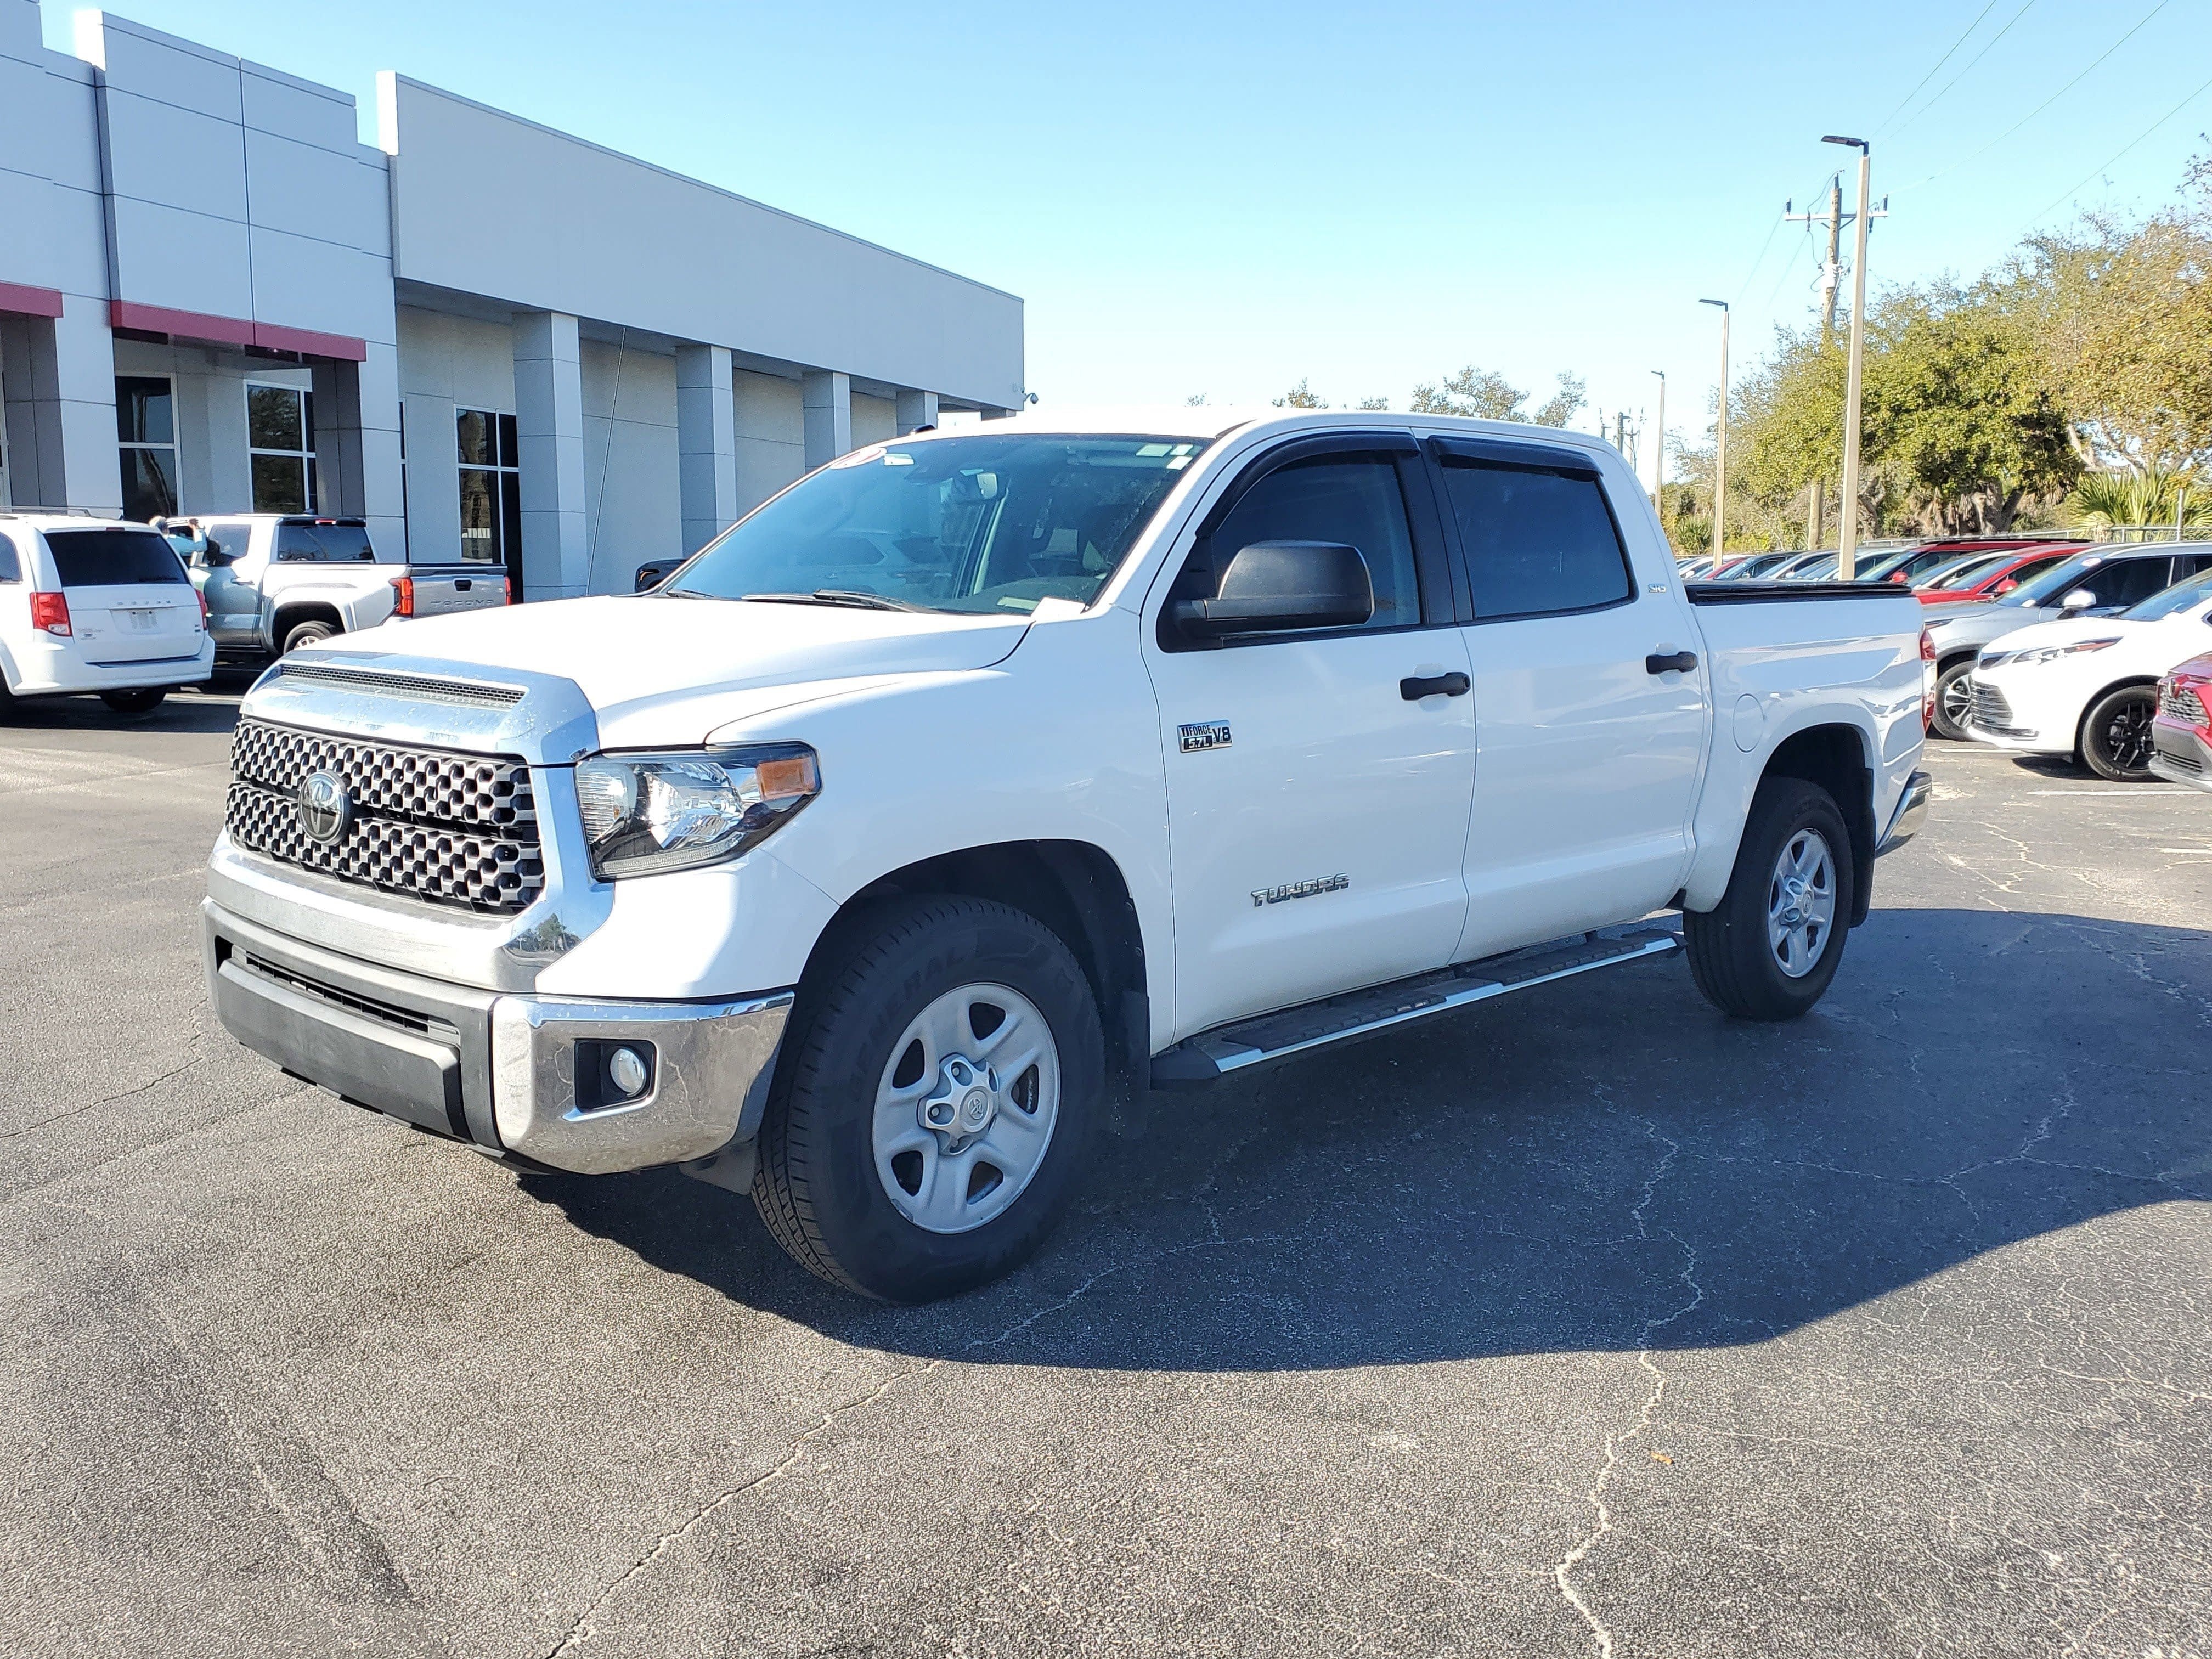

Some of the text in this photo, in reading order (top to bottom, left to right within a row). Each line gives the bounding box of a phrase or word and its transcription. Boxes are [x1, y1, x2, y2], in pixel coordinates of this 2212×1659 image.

[430, 599, 494, 608] TACOMA
[1212, 727, 1231, 743] V8
[1251, 873, 1350, 907] TUNDRA
